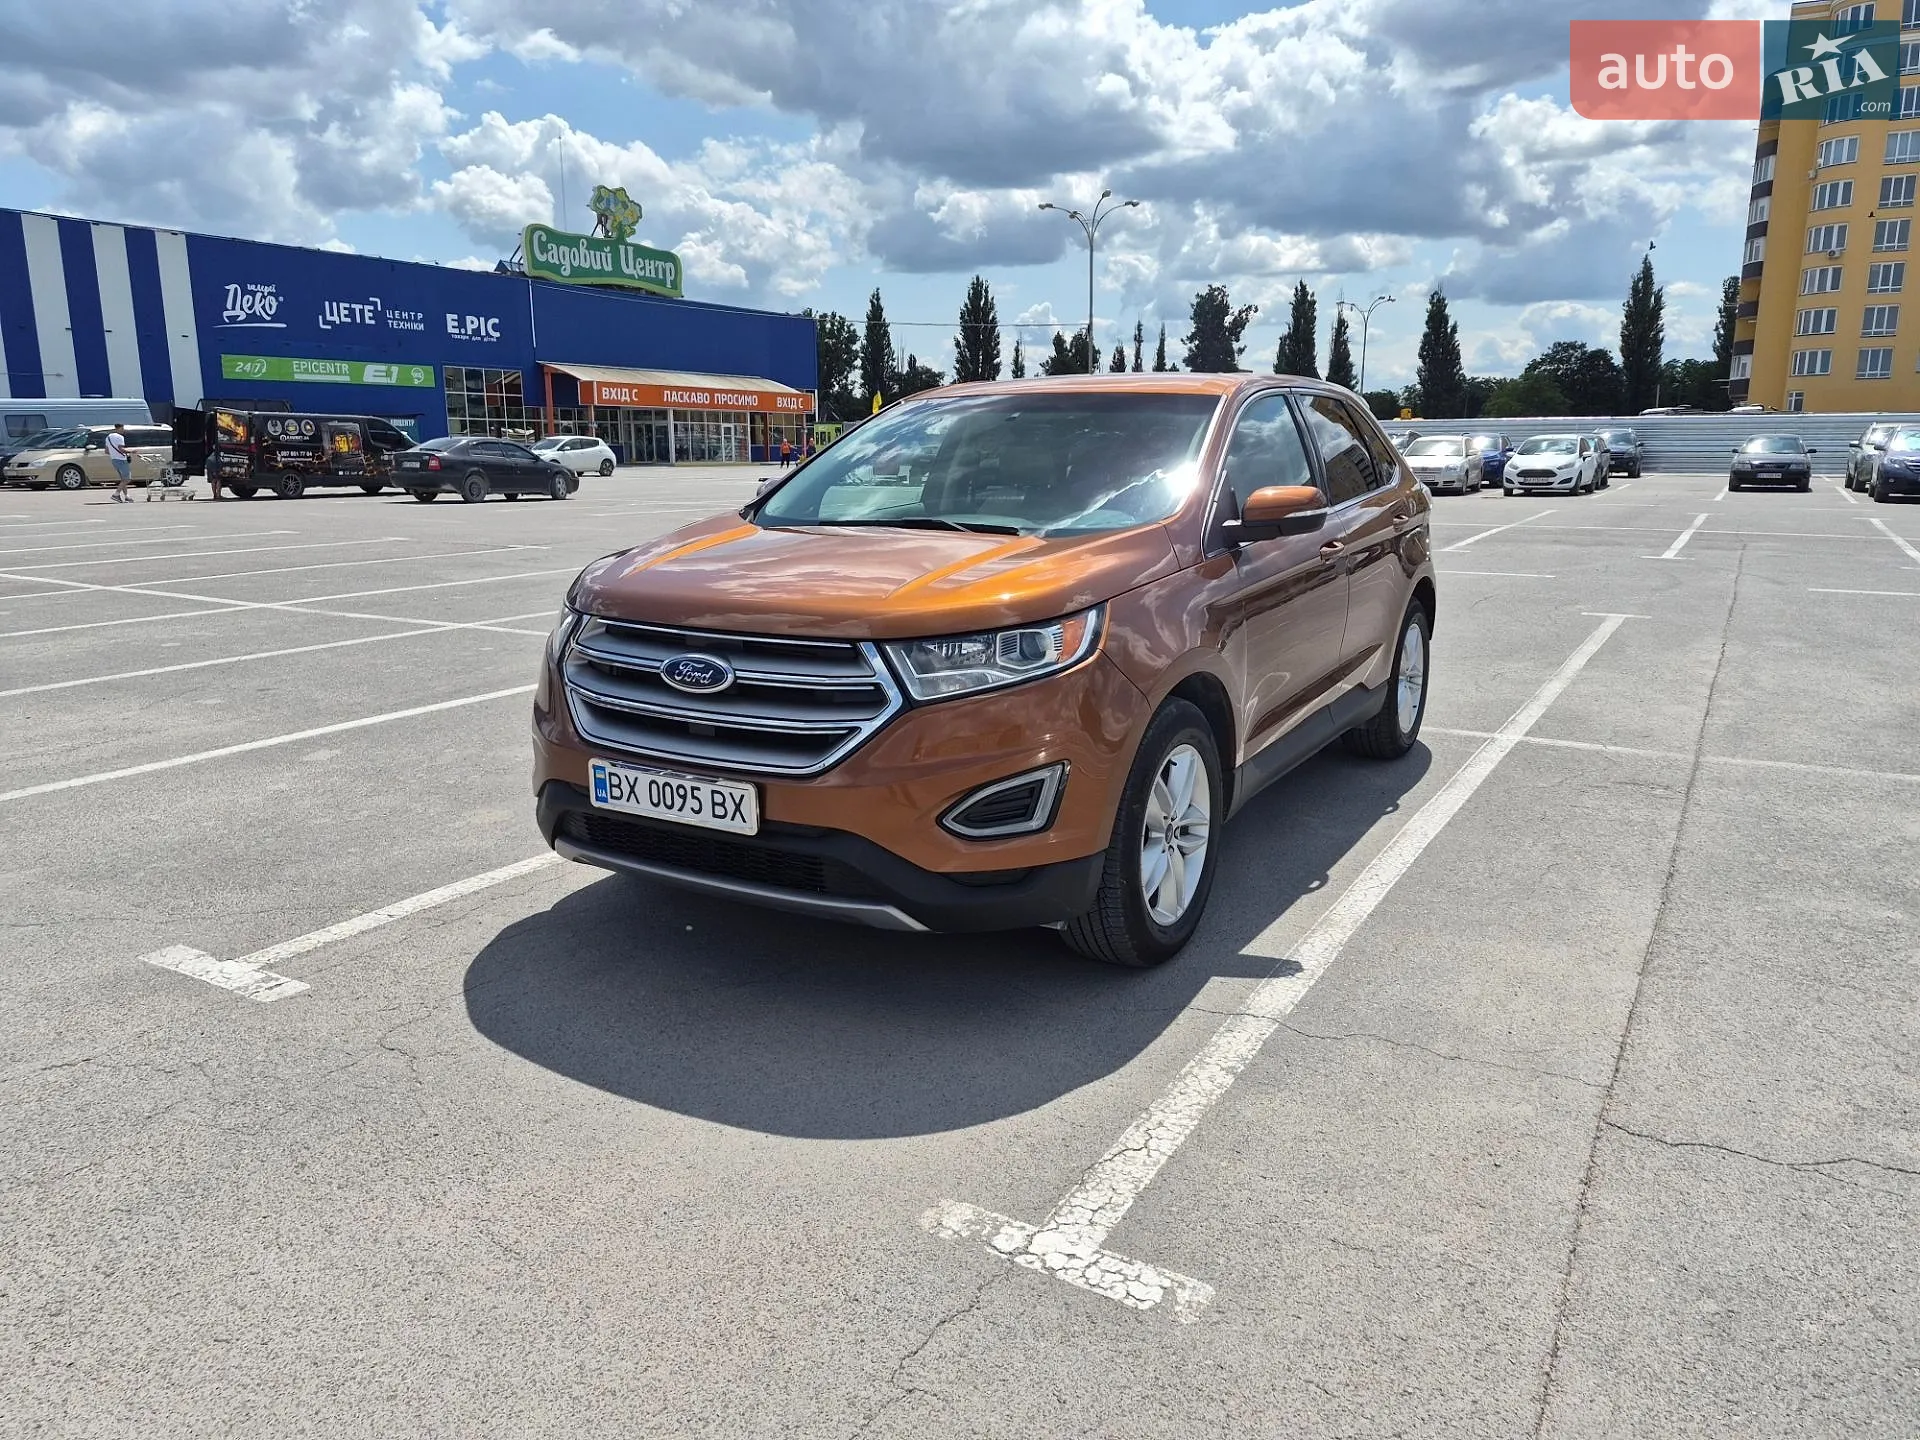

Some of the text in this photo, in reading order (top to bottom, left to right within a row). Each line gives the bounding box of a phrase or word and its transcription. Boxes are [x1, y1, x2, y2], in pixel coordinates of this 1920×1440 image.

[532, 230, 675, 289] Садовий Центр
[323, 300, 376, 327] ЦЕТЕ
[386, 309, 424, 321] ЦЕНТР
[387, 319, 425, 331] ТЕХНІКИ
[292, 360, 350, 375] EPICENTR
[601, 388, 639, 402] ВХІД С
[714, 393, 759, 406] ПРОСИМО
[777, 396, 804, 410] ВХІД С
[674, 660, 714, 684] Ford
[596, 787, 608, 799] UA
[608, 771, 747, 823] BX 0095 BX
